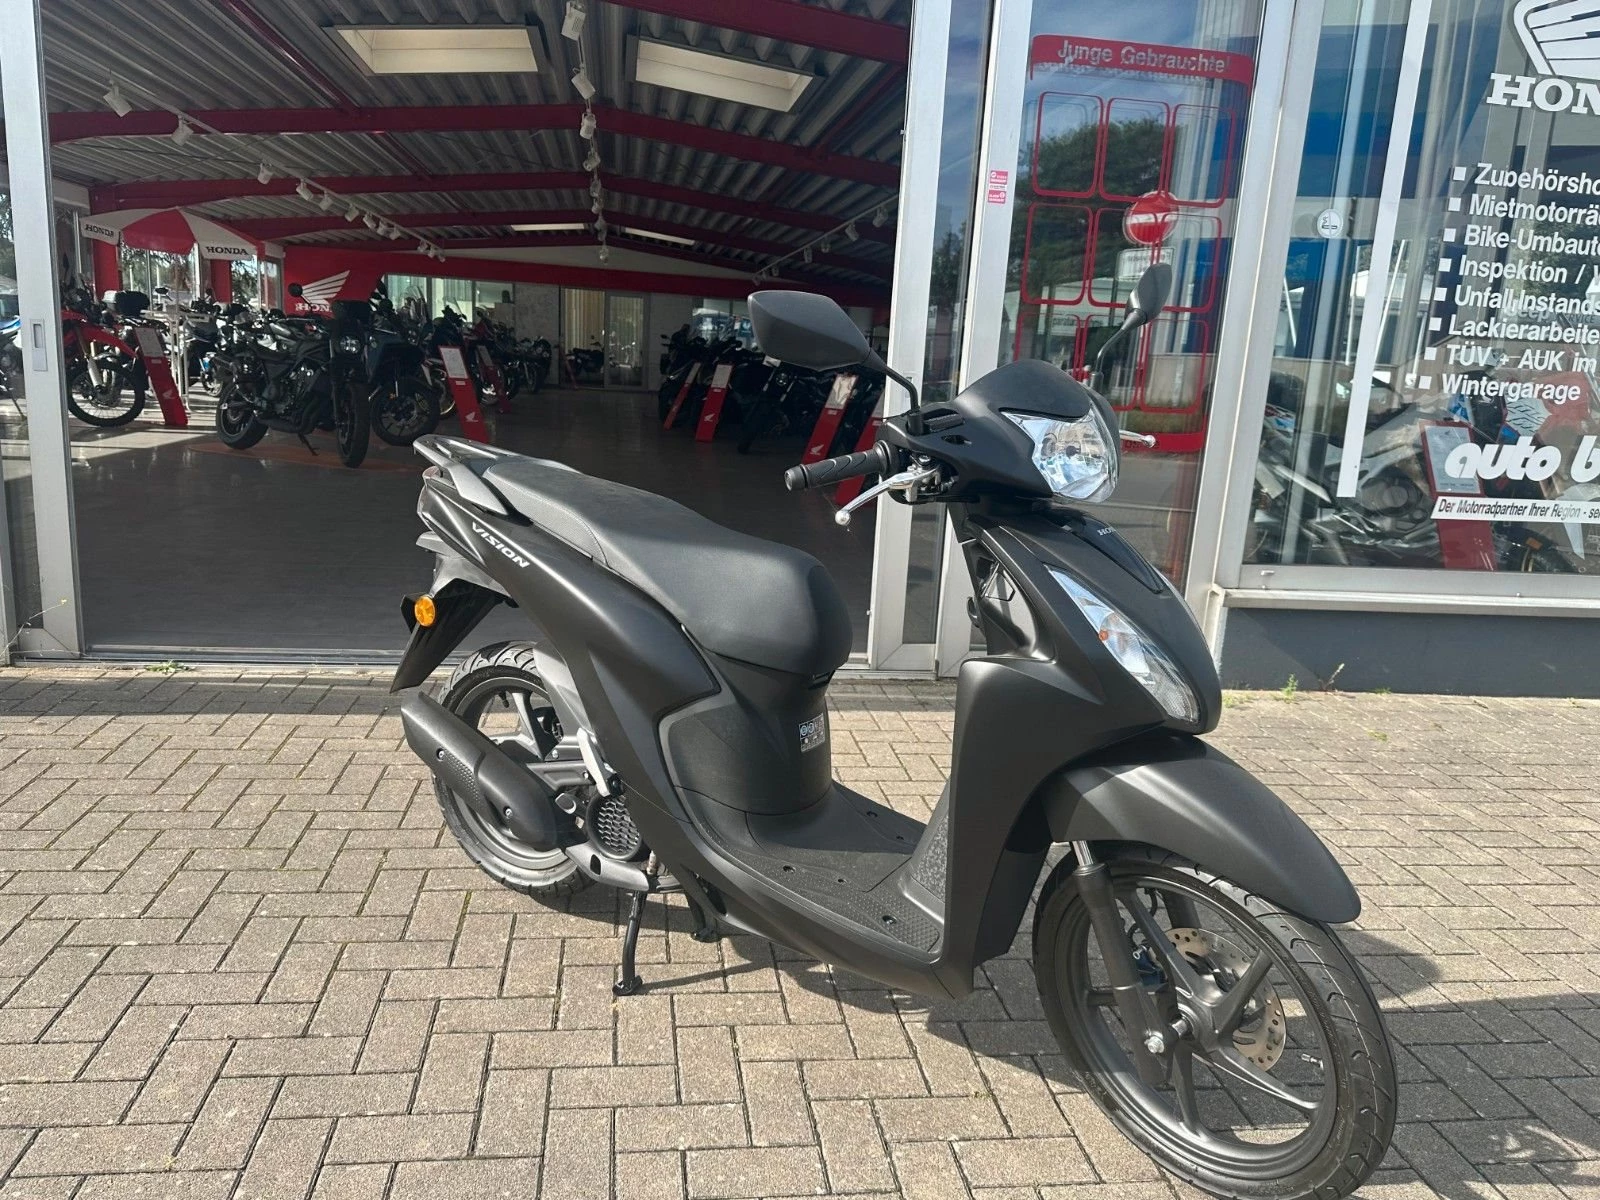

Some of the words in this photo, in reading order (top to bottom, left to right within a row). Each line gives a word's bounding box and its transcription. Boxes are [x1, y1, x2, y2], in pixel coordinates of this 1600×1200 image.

[1058, 40, 1113, 66] Junge
[1120, 46, 1225, 73] Gebrauchte
[1486, 72, 1600, 116] HON
[1469, 193, 1600, 226] Mietmotorrä
[205, 246, 249, 255] HONDA
[1464, 224, 1600, 256] Bike-Umbaut
[1459, 254, 1568, 284] Inspektion
[295, 303, 332, 312] HON
[1448, 314, 1600, 346] Lackierarbeite
[1447, 341, 1492, 367] TÜV
[1517, 349, 1565, 372] AUK
[1571, 352, 1597, 374] im
[1442, 373, 1581, 405] Wintergarage
[1445, 436, 1561, 482] auto
[1438, 499, 1455, 513] Der
[1457, 500, 1526, 518] Motorradpartner
[1528, 503, 1550, 517] Ihrer
[1551, 504, 1580, 520] Region
[472, 521, 530, 568] VISION
